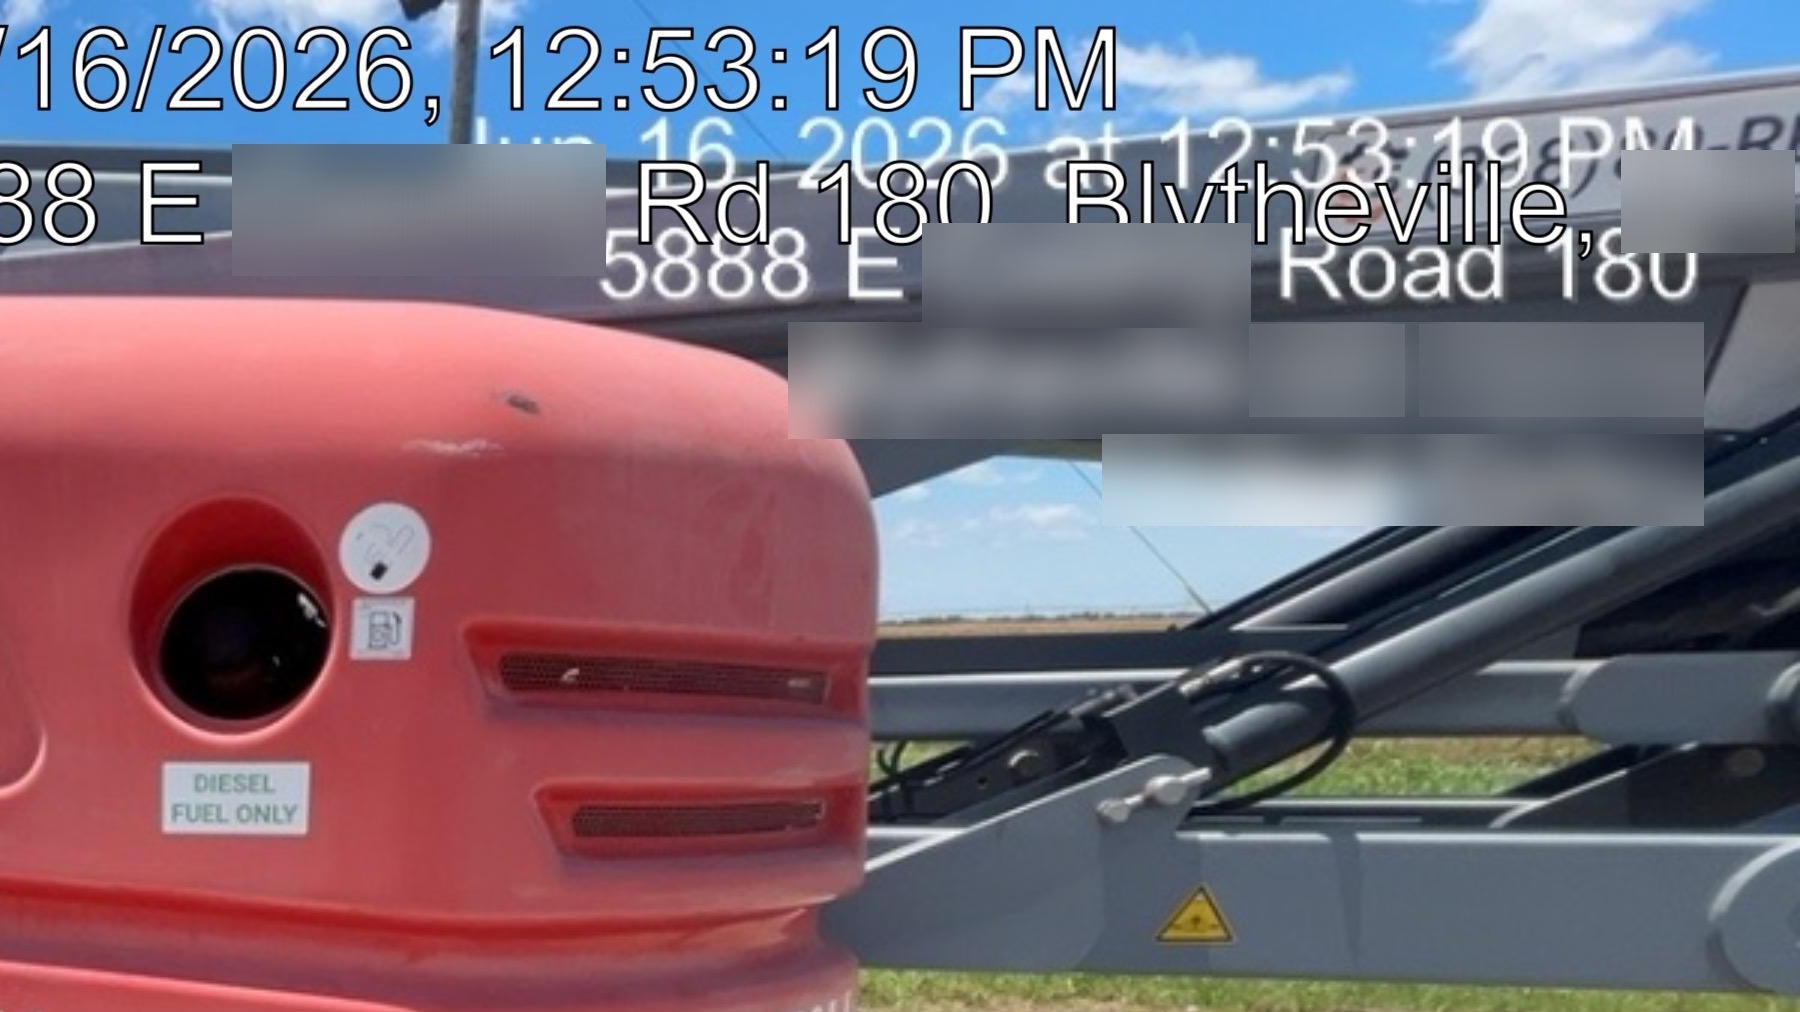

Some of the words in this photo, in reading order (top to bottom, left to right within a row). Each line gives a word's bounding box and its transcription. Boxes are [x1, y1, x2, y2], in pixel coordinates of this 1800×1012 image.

[193, 773, 276, 794] DIESEL
[171, 803, 228, 824] FUEL
[236, 803, 298, 825] ONLY
